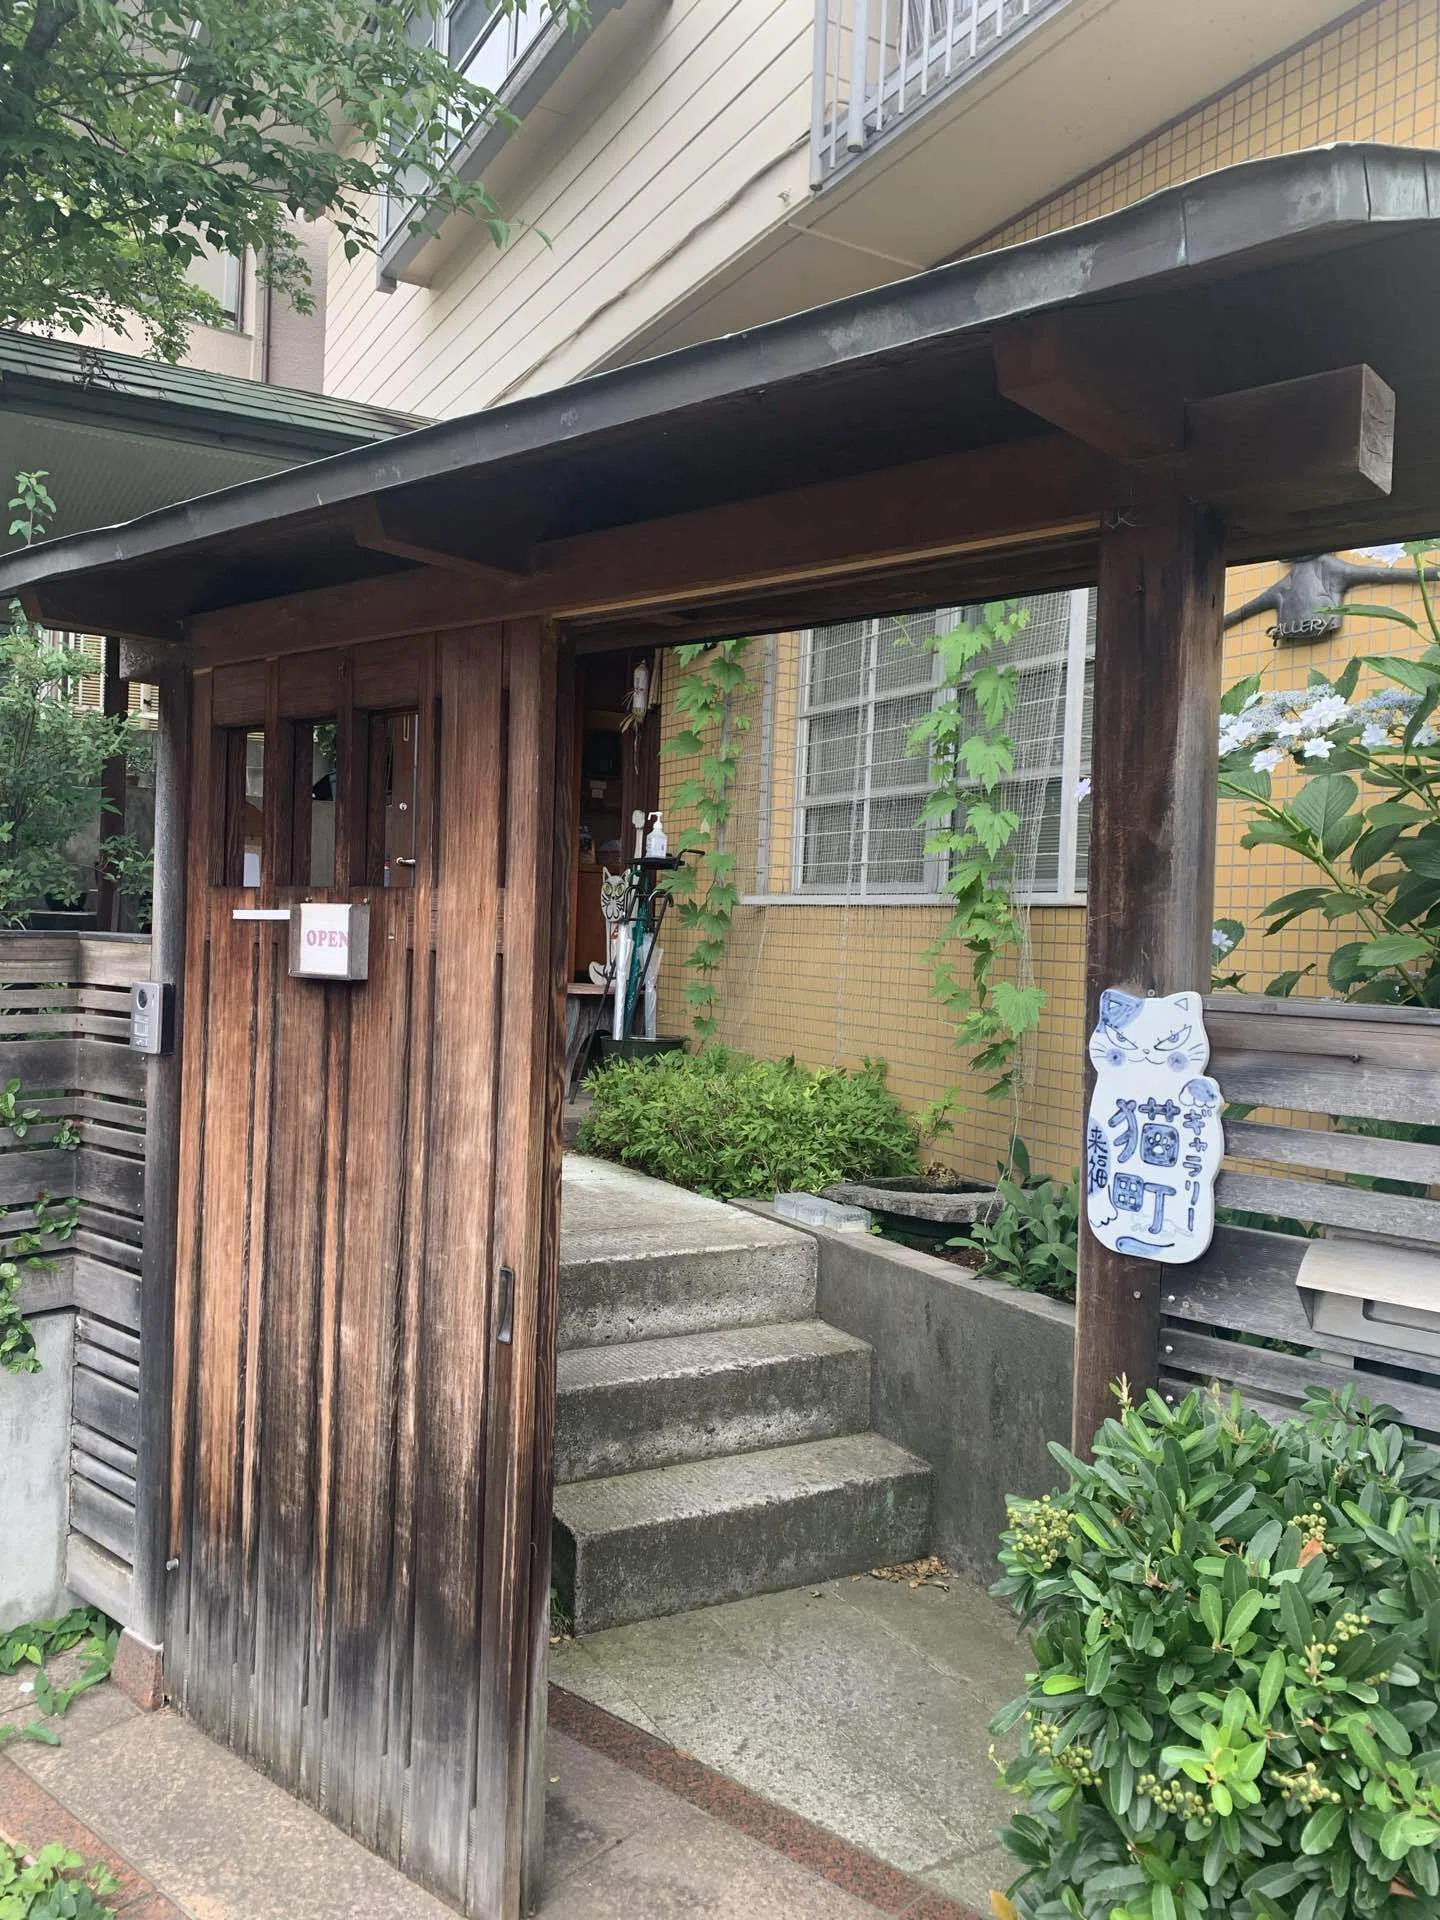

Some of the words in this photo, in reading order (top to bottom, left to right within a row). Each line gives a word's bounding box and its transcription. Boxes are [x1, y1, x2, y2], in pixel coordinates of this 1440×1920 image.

[307, 930, 349, 947] OPEN
[1108, 1097, 1181, 1235] 猫町
[1182, 1108, 1213, 1233] ギャラリー
